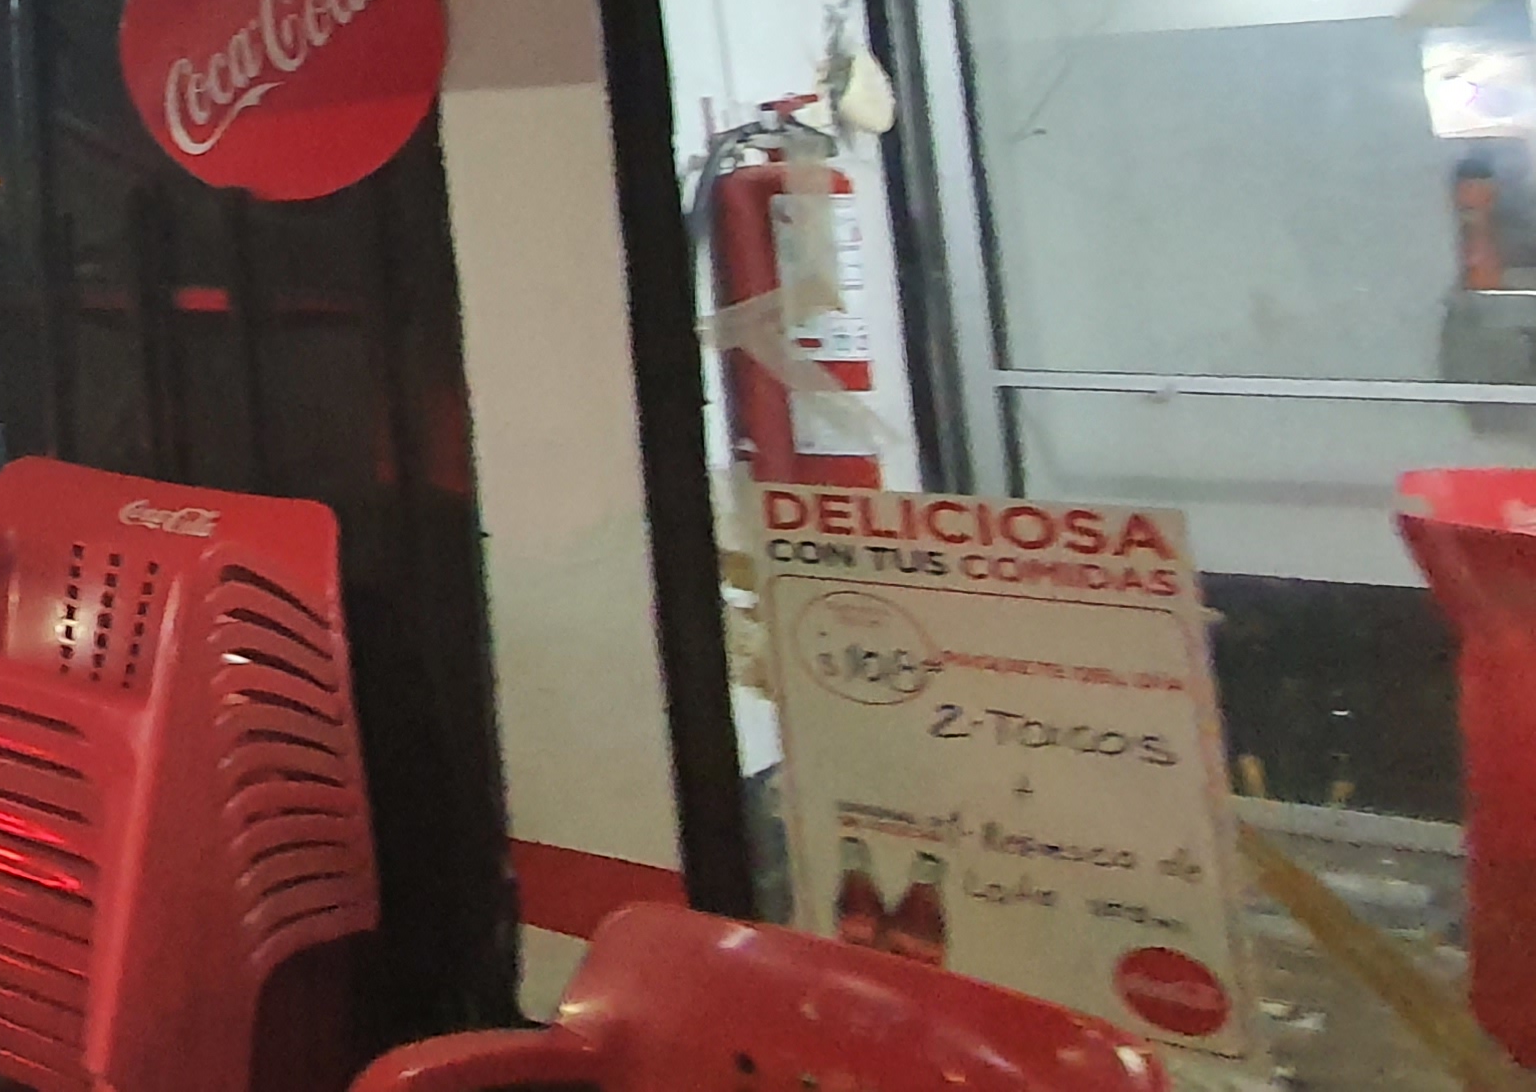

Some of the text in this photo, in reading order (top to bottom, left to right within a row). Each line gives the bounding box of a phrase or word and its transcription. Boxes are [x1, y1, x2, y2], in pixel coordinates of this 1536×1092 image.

[763, 490, 1178, 559] DELICIOSA
[768, 539, 1177, 597] CON TUS COMIDAS
